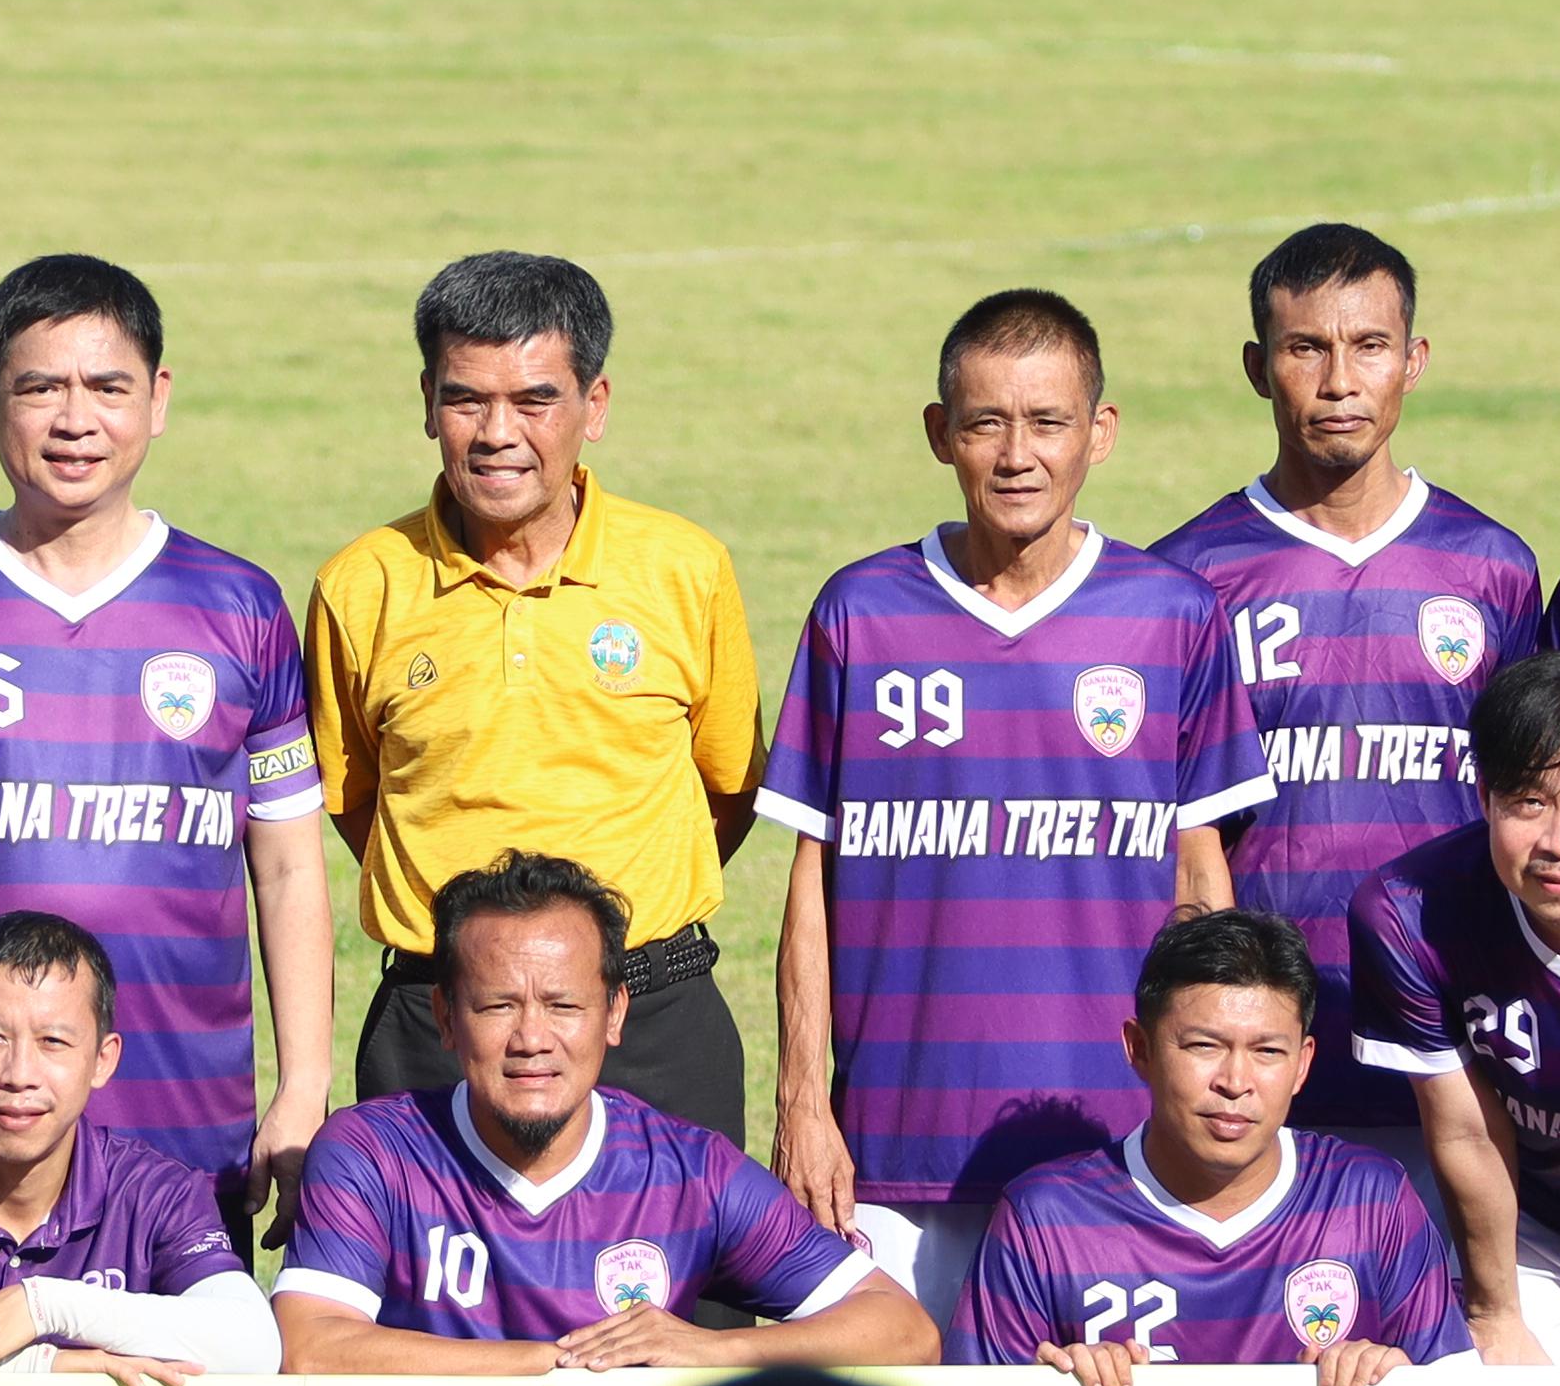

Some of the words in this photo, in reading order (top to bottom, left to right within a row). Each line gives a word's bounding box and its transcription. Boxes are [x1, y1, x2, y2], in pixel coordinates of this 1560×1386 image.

[1233, 601, 1303, 687] 12
[873, 667, 966, 751] 99
[249, 741, 310, 781] TAIN
[1354, 724, 1446, 787] TREE
[64, 784, 173, 848] TREE
[180, 786, 237, 852] TAK
[839, 798, 990, 860] BANANA
[1001, 799, 1103, 864] TREE
[1110, 801, 1179, 865] TAK
[1462, 994, 1542, 1076] 29
[422, 1223, 490, 1310] 10
[1308, 1281, 1332, 1292] TAK
[1082, 1279, 1179, 1363] 22
